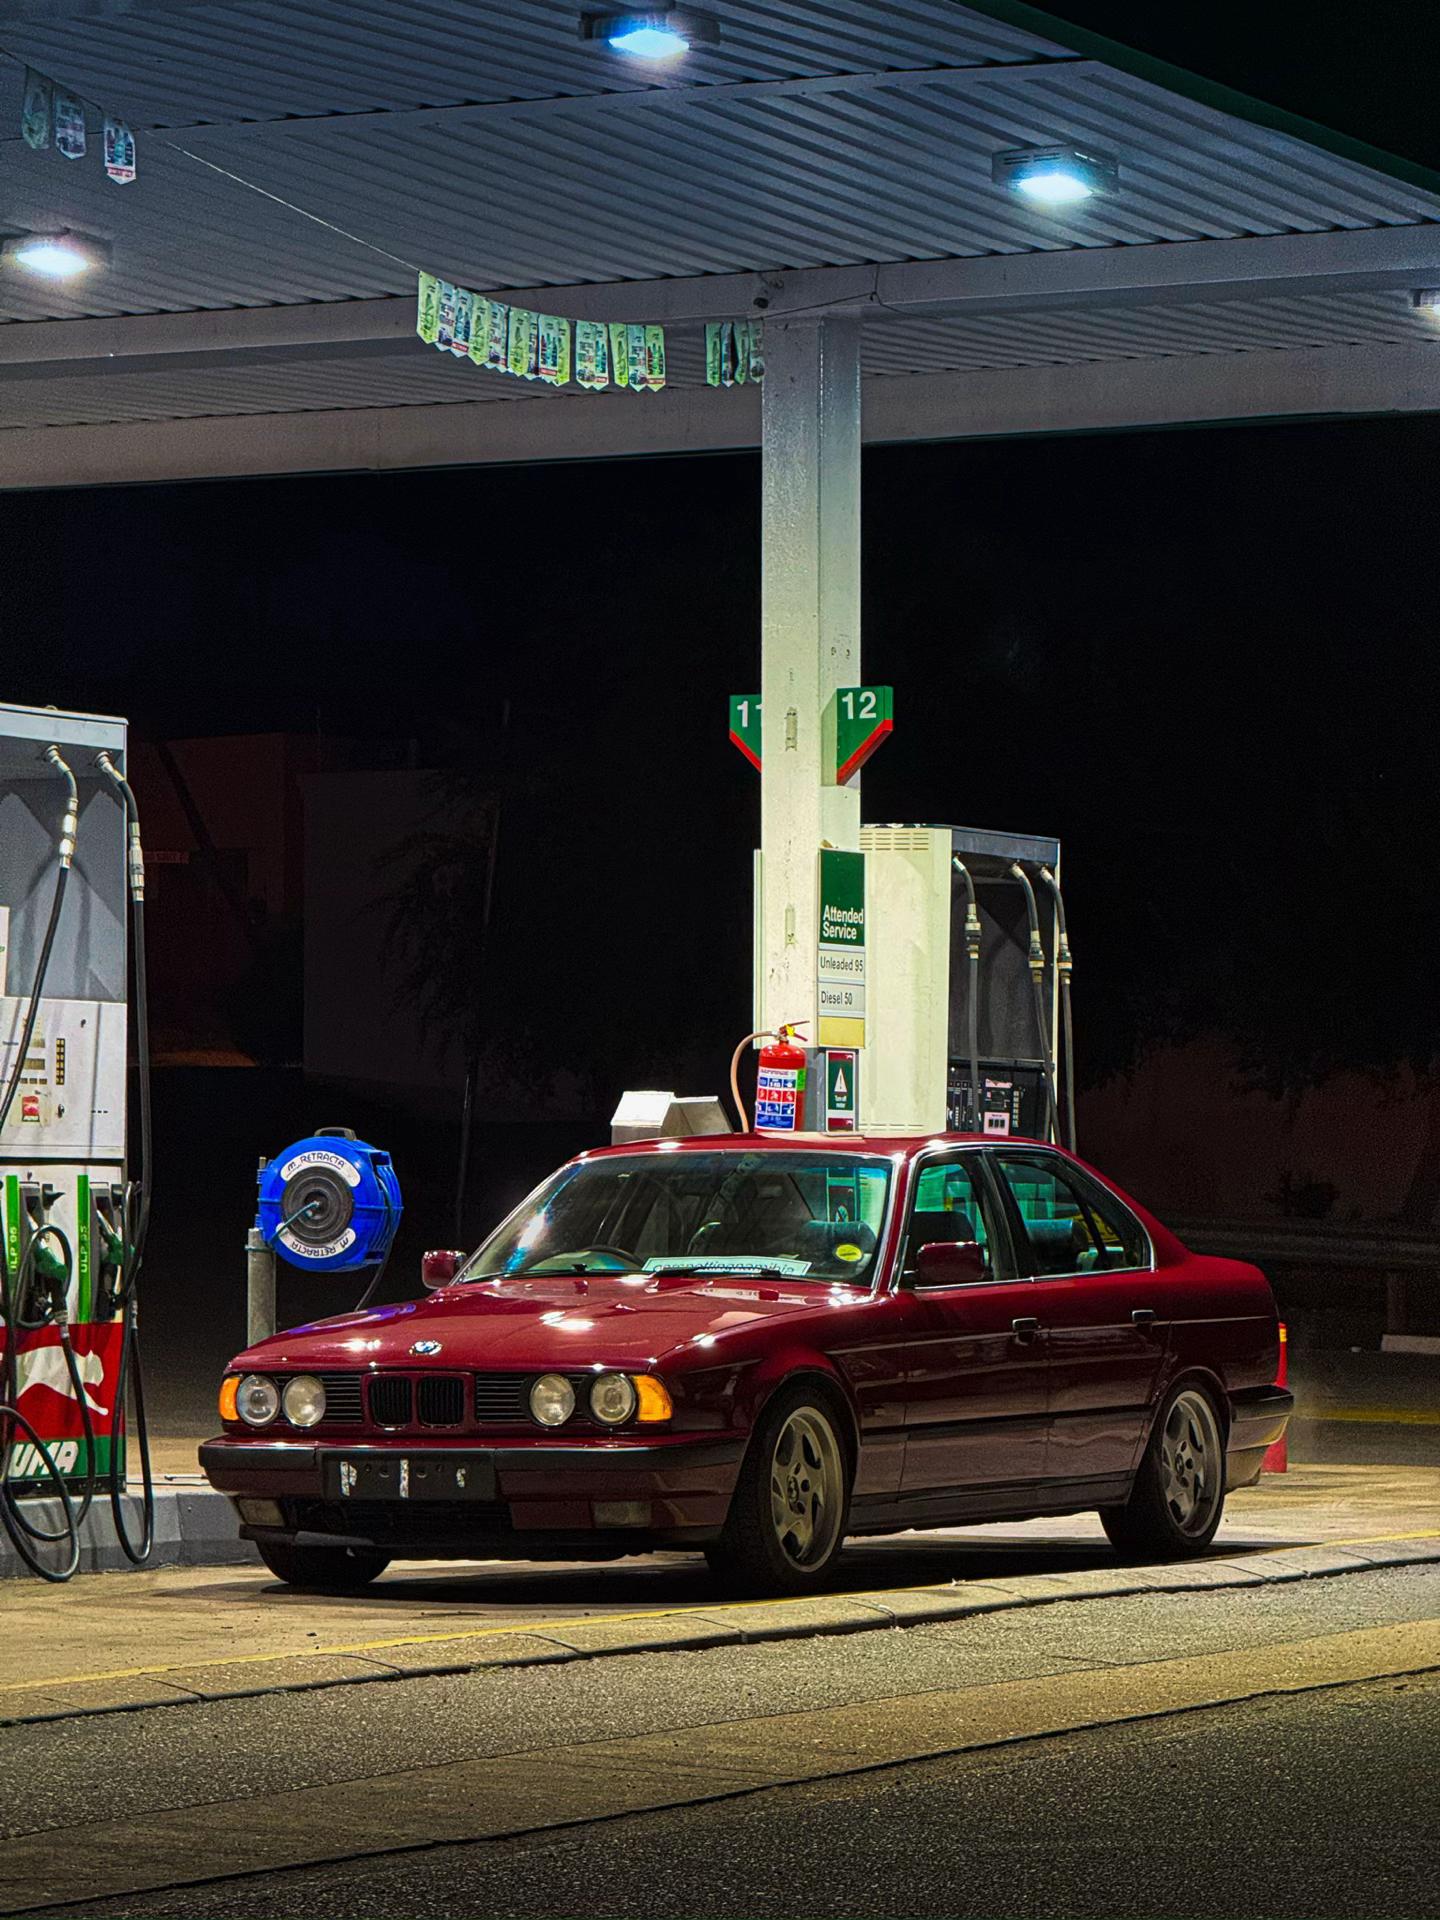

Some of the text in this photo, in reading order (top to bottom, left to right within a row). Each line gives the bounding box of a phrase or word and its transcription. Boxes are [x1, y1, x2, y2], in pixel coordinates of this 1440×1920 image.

[737, 700, 762, 728] 1
[842, 691, 877, 720] 12
[823, 904, 864, 924] Attended
[822, 921, 857, 940] Service
[820, 956, 864, 972] Unleaded 95
[821, 990, 853, 1005] Diesel 50
[300, 1152, 345, 1168] RETRACTA
[80, 1246, 88, 1273] ULP
